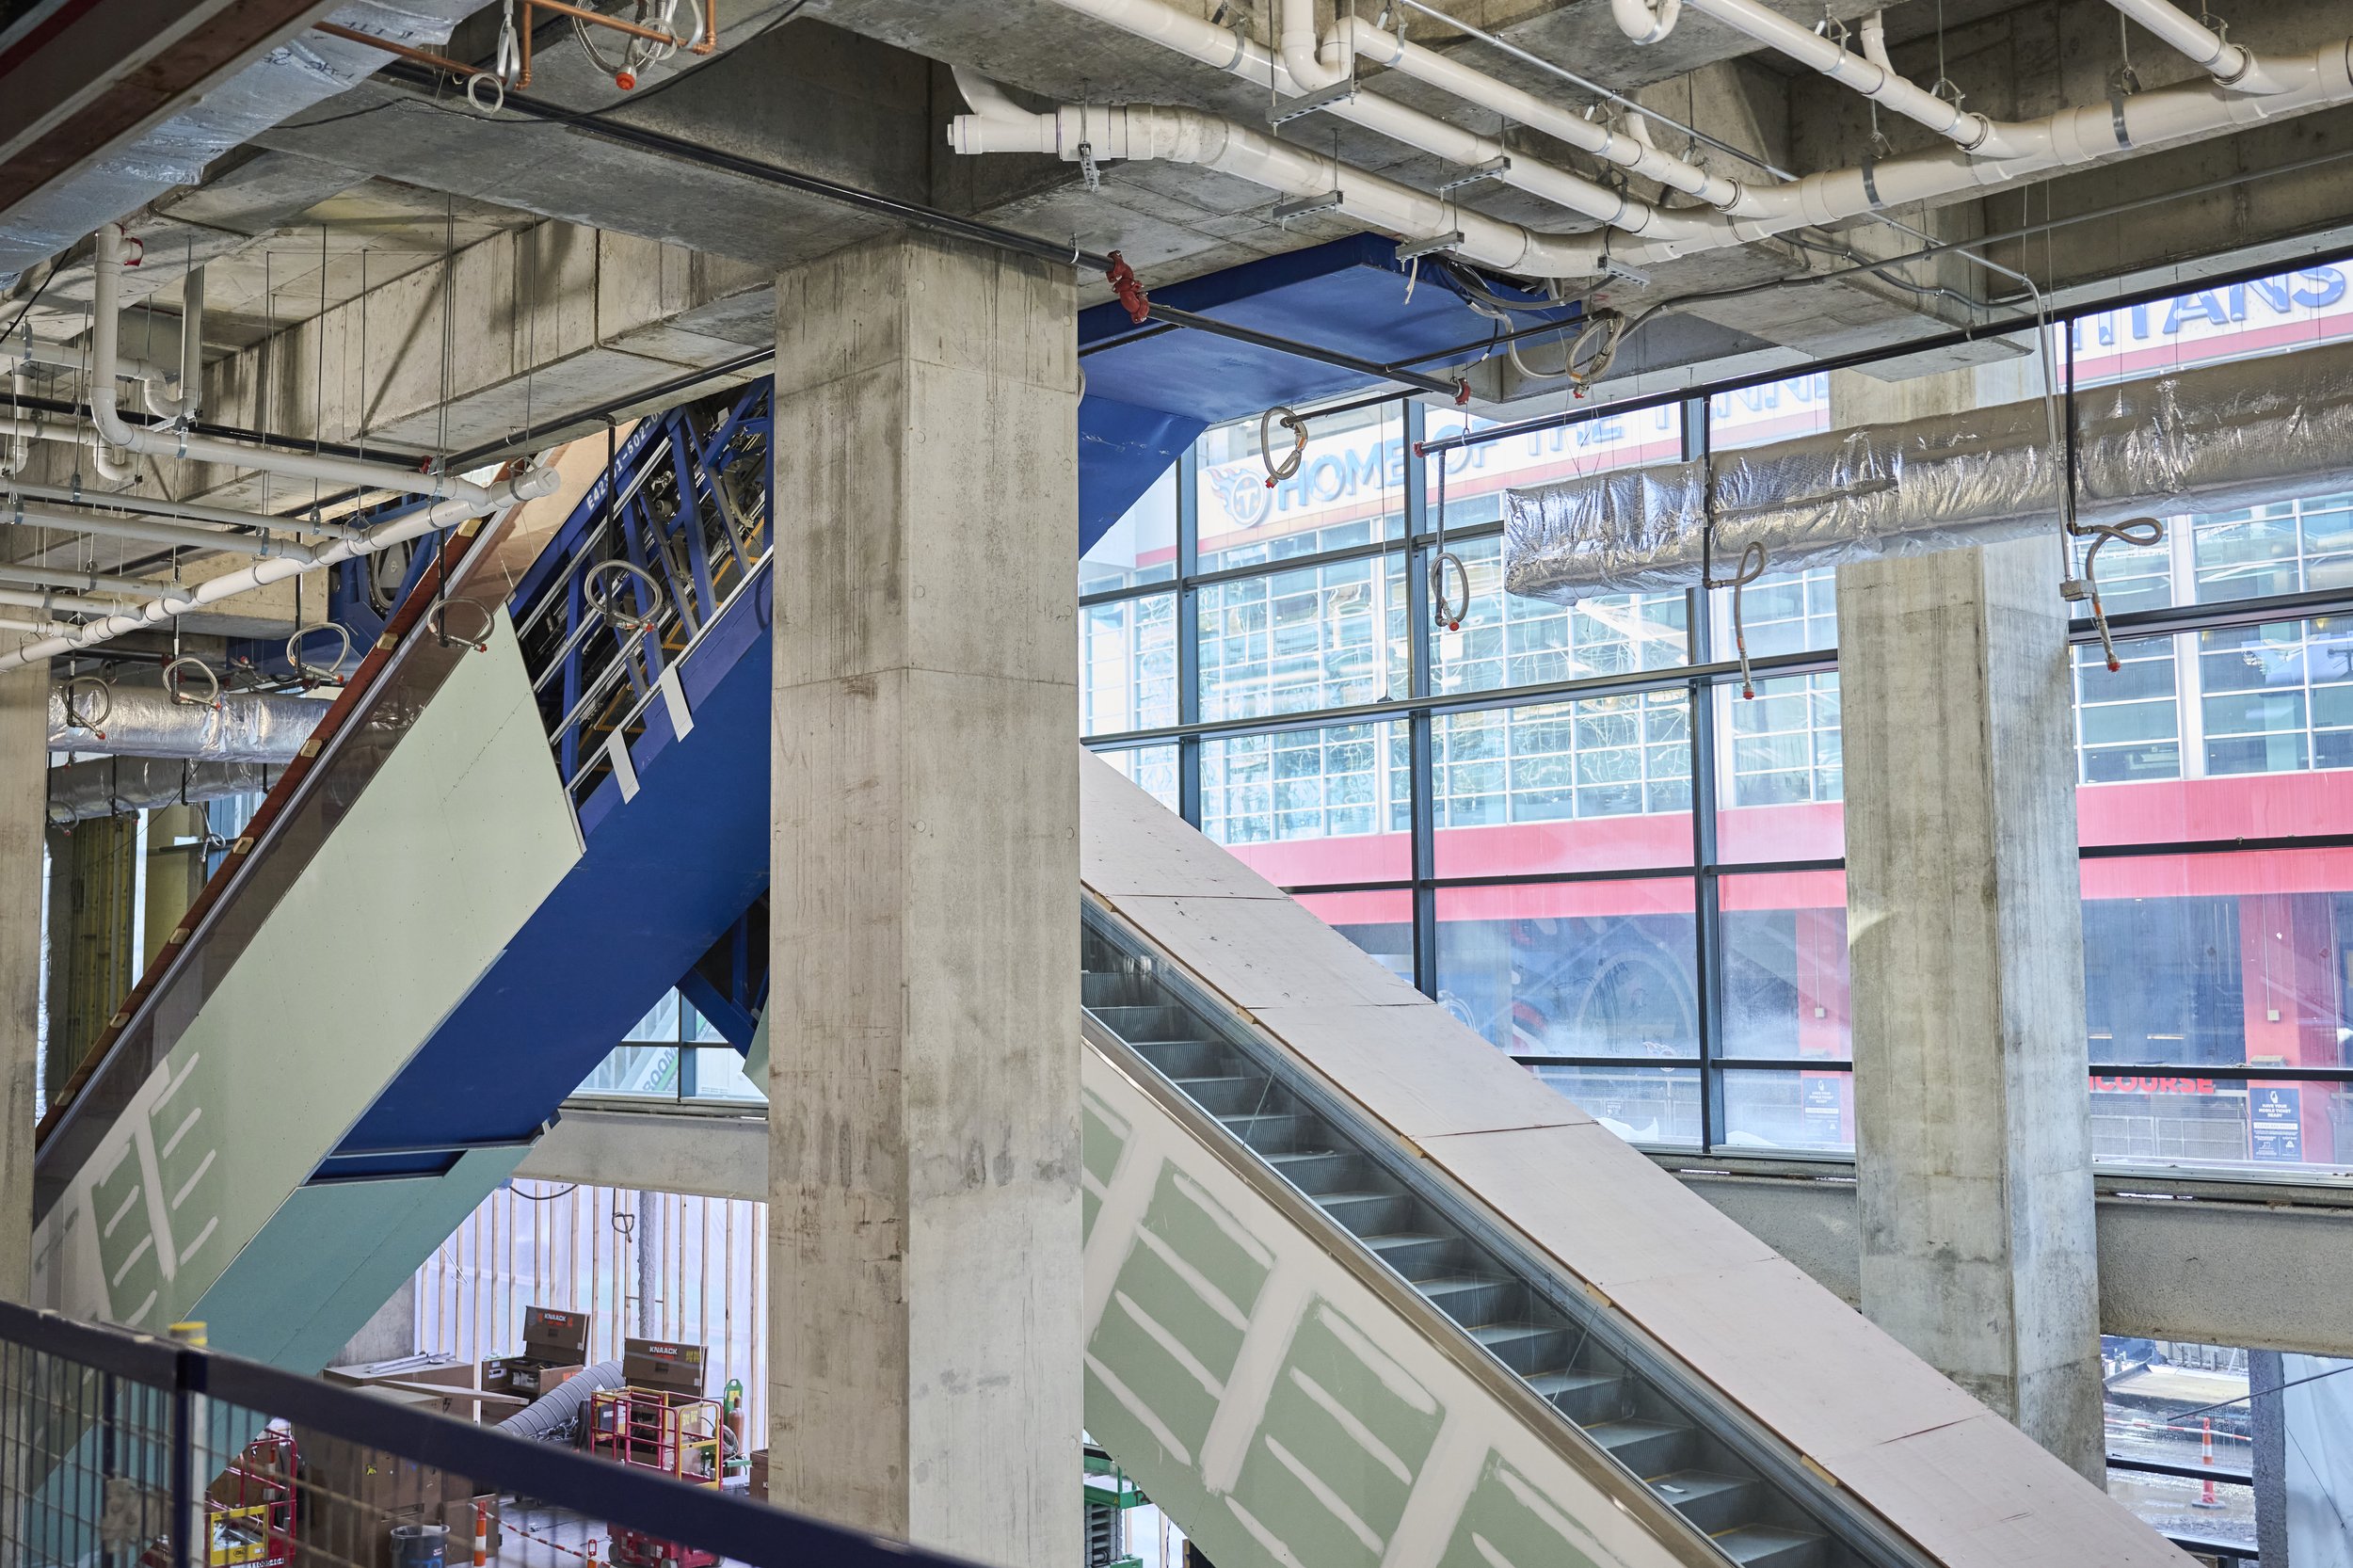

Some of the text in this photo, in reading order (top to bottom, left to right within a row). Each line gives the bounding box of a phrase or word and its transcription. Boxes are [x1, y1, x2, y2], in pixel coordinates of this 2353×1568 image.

[586, 411, 663, 511] E421-502-0
[1278, 437, 1404, 511] HOME
[649, 1346, 678, 1354] KNAACK
